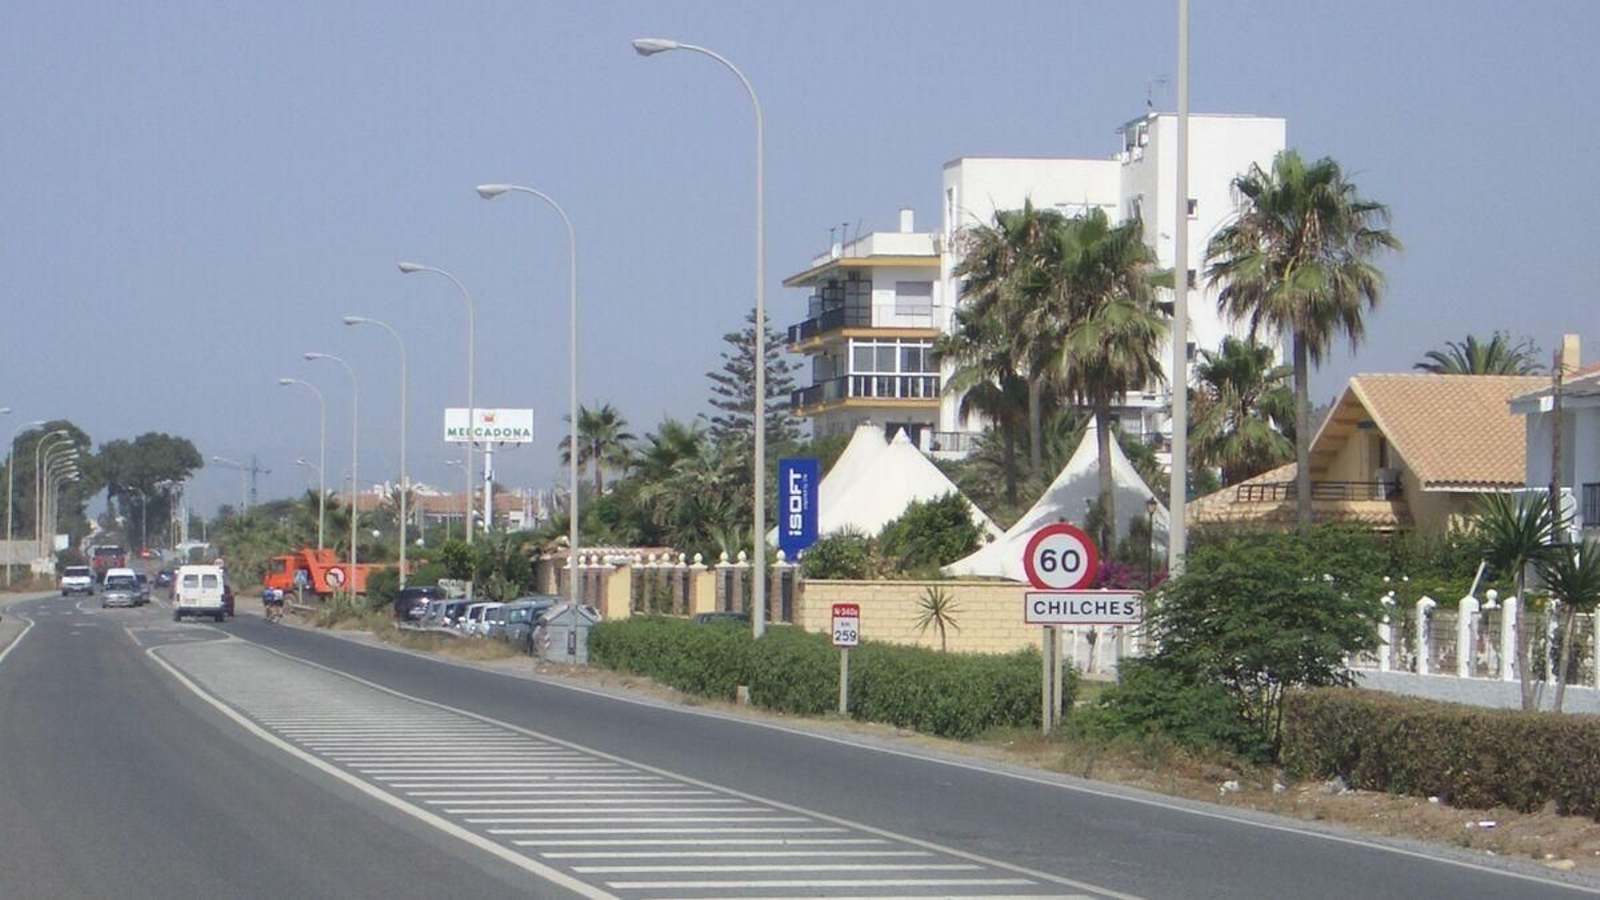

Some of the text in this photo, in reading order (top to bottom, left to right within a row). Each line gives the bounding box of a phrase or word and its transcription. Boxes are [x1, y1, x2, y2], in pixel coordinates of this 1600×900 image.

[1040, 549, 1080, 572] 60
[1034, 601, 1135, 615] CHILCHES
[835, 630, 857, 642] 259
